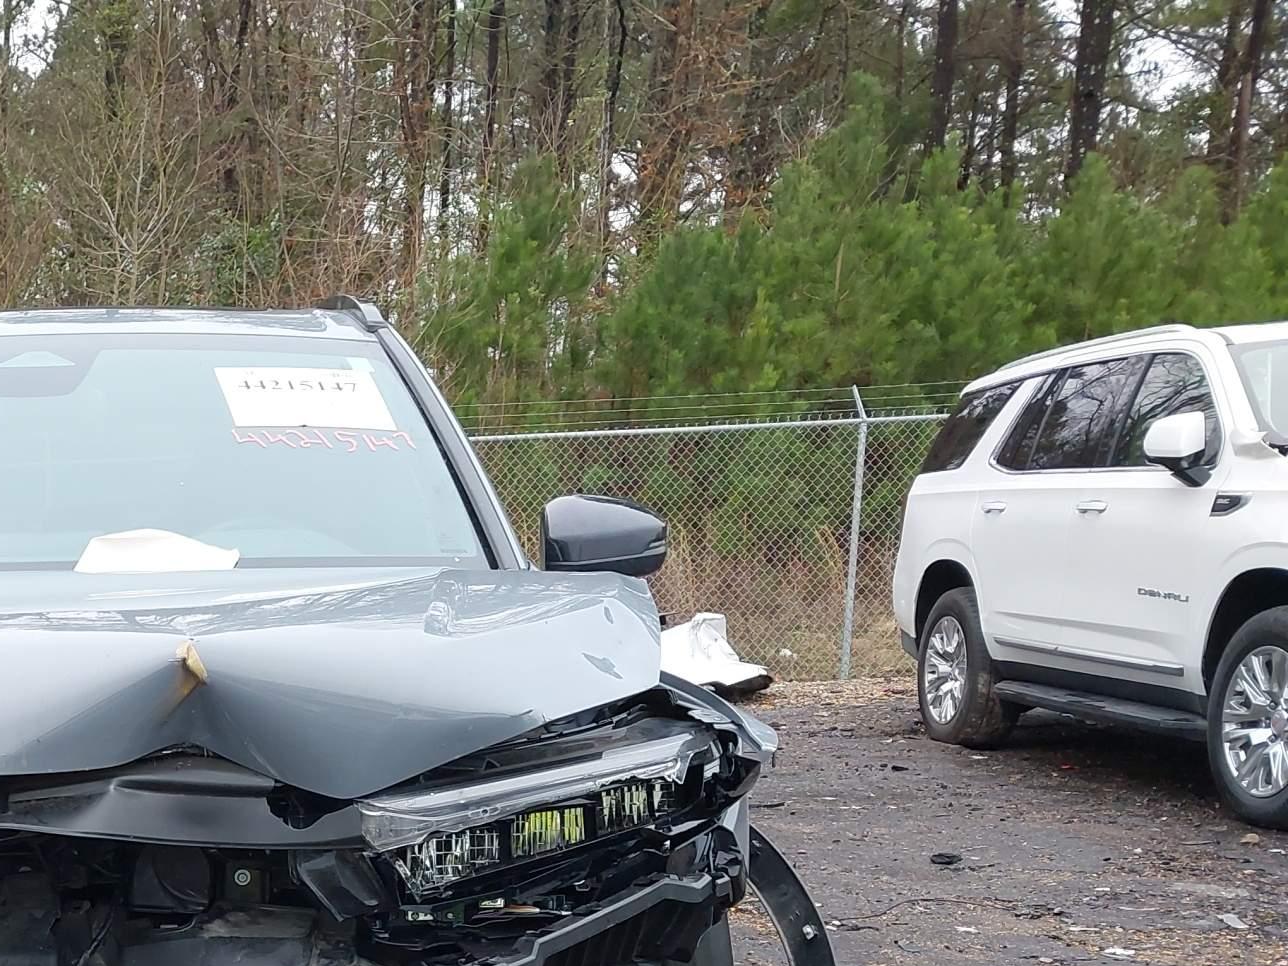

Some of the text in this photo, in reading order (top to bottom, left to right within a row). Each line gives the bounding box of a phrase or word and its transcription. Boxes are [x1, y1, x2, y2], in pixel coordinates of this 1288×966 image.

[238, 380, 357, 392] 44215147
[231, 428, 416, 452] 44215147
[1137, 587, 1189, 603] DENALI
